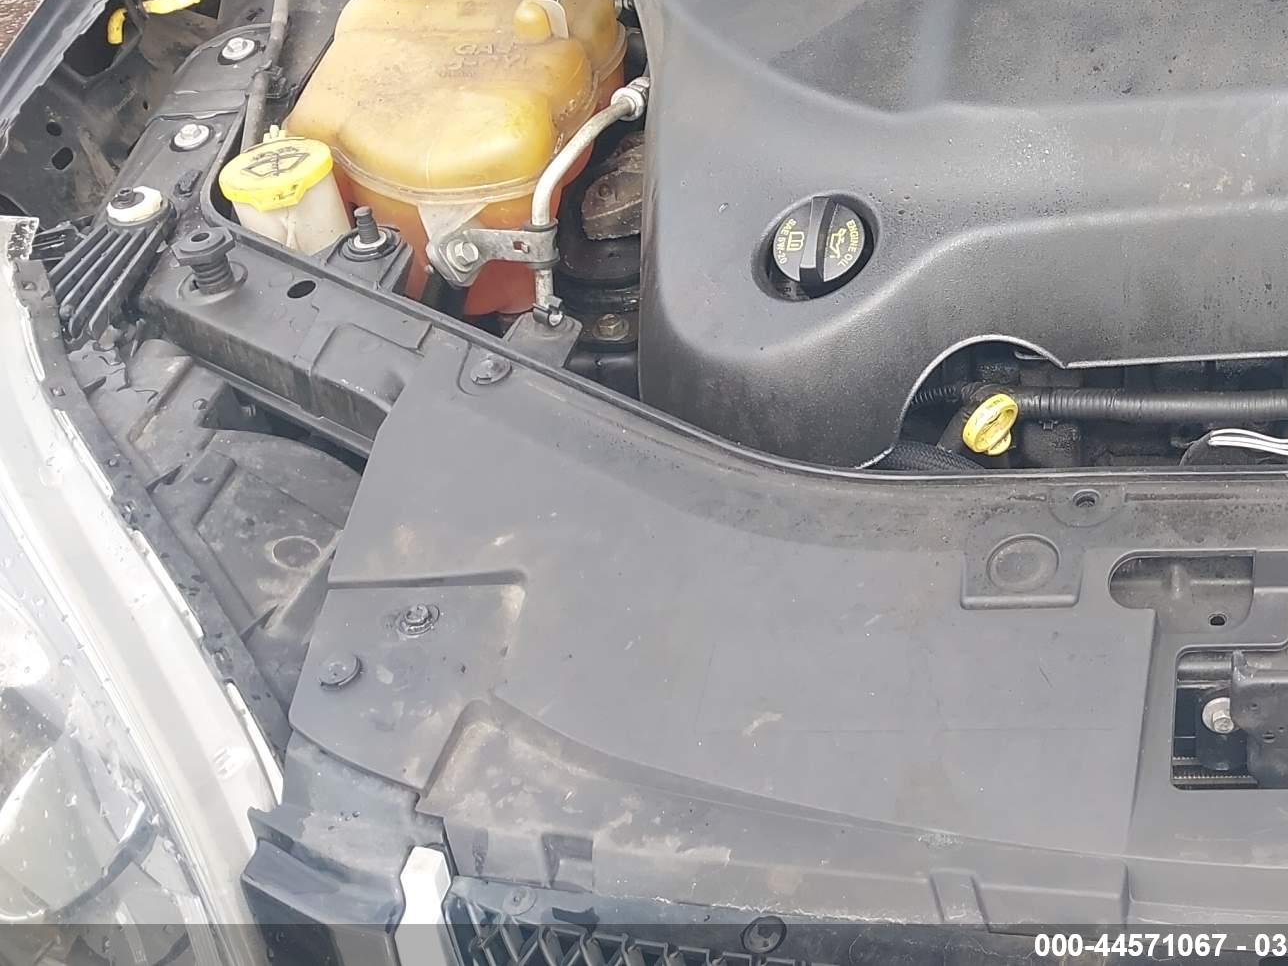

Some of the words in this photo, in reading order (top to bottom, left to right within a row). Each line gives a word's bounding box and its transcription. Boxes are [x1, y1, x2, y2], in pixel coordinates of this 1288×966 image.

[780, 218, 797, 236] SAE
[846, 219, 859, 253] ENGINE
[838, 253, 853, 267] OIL
